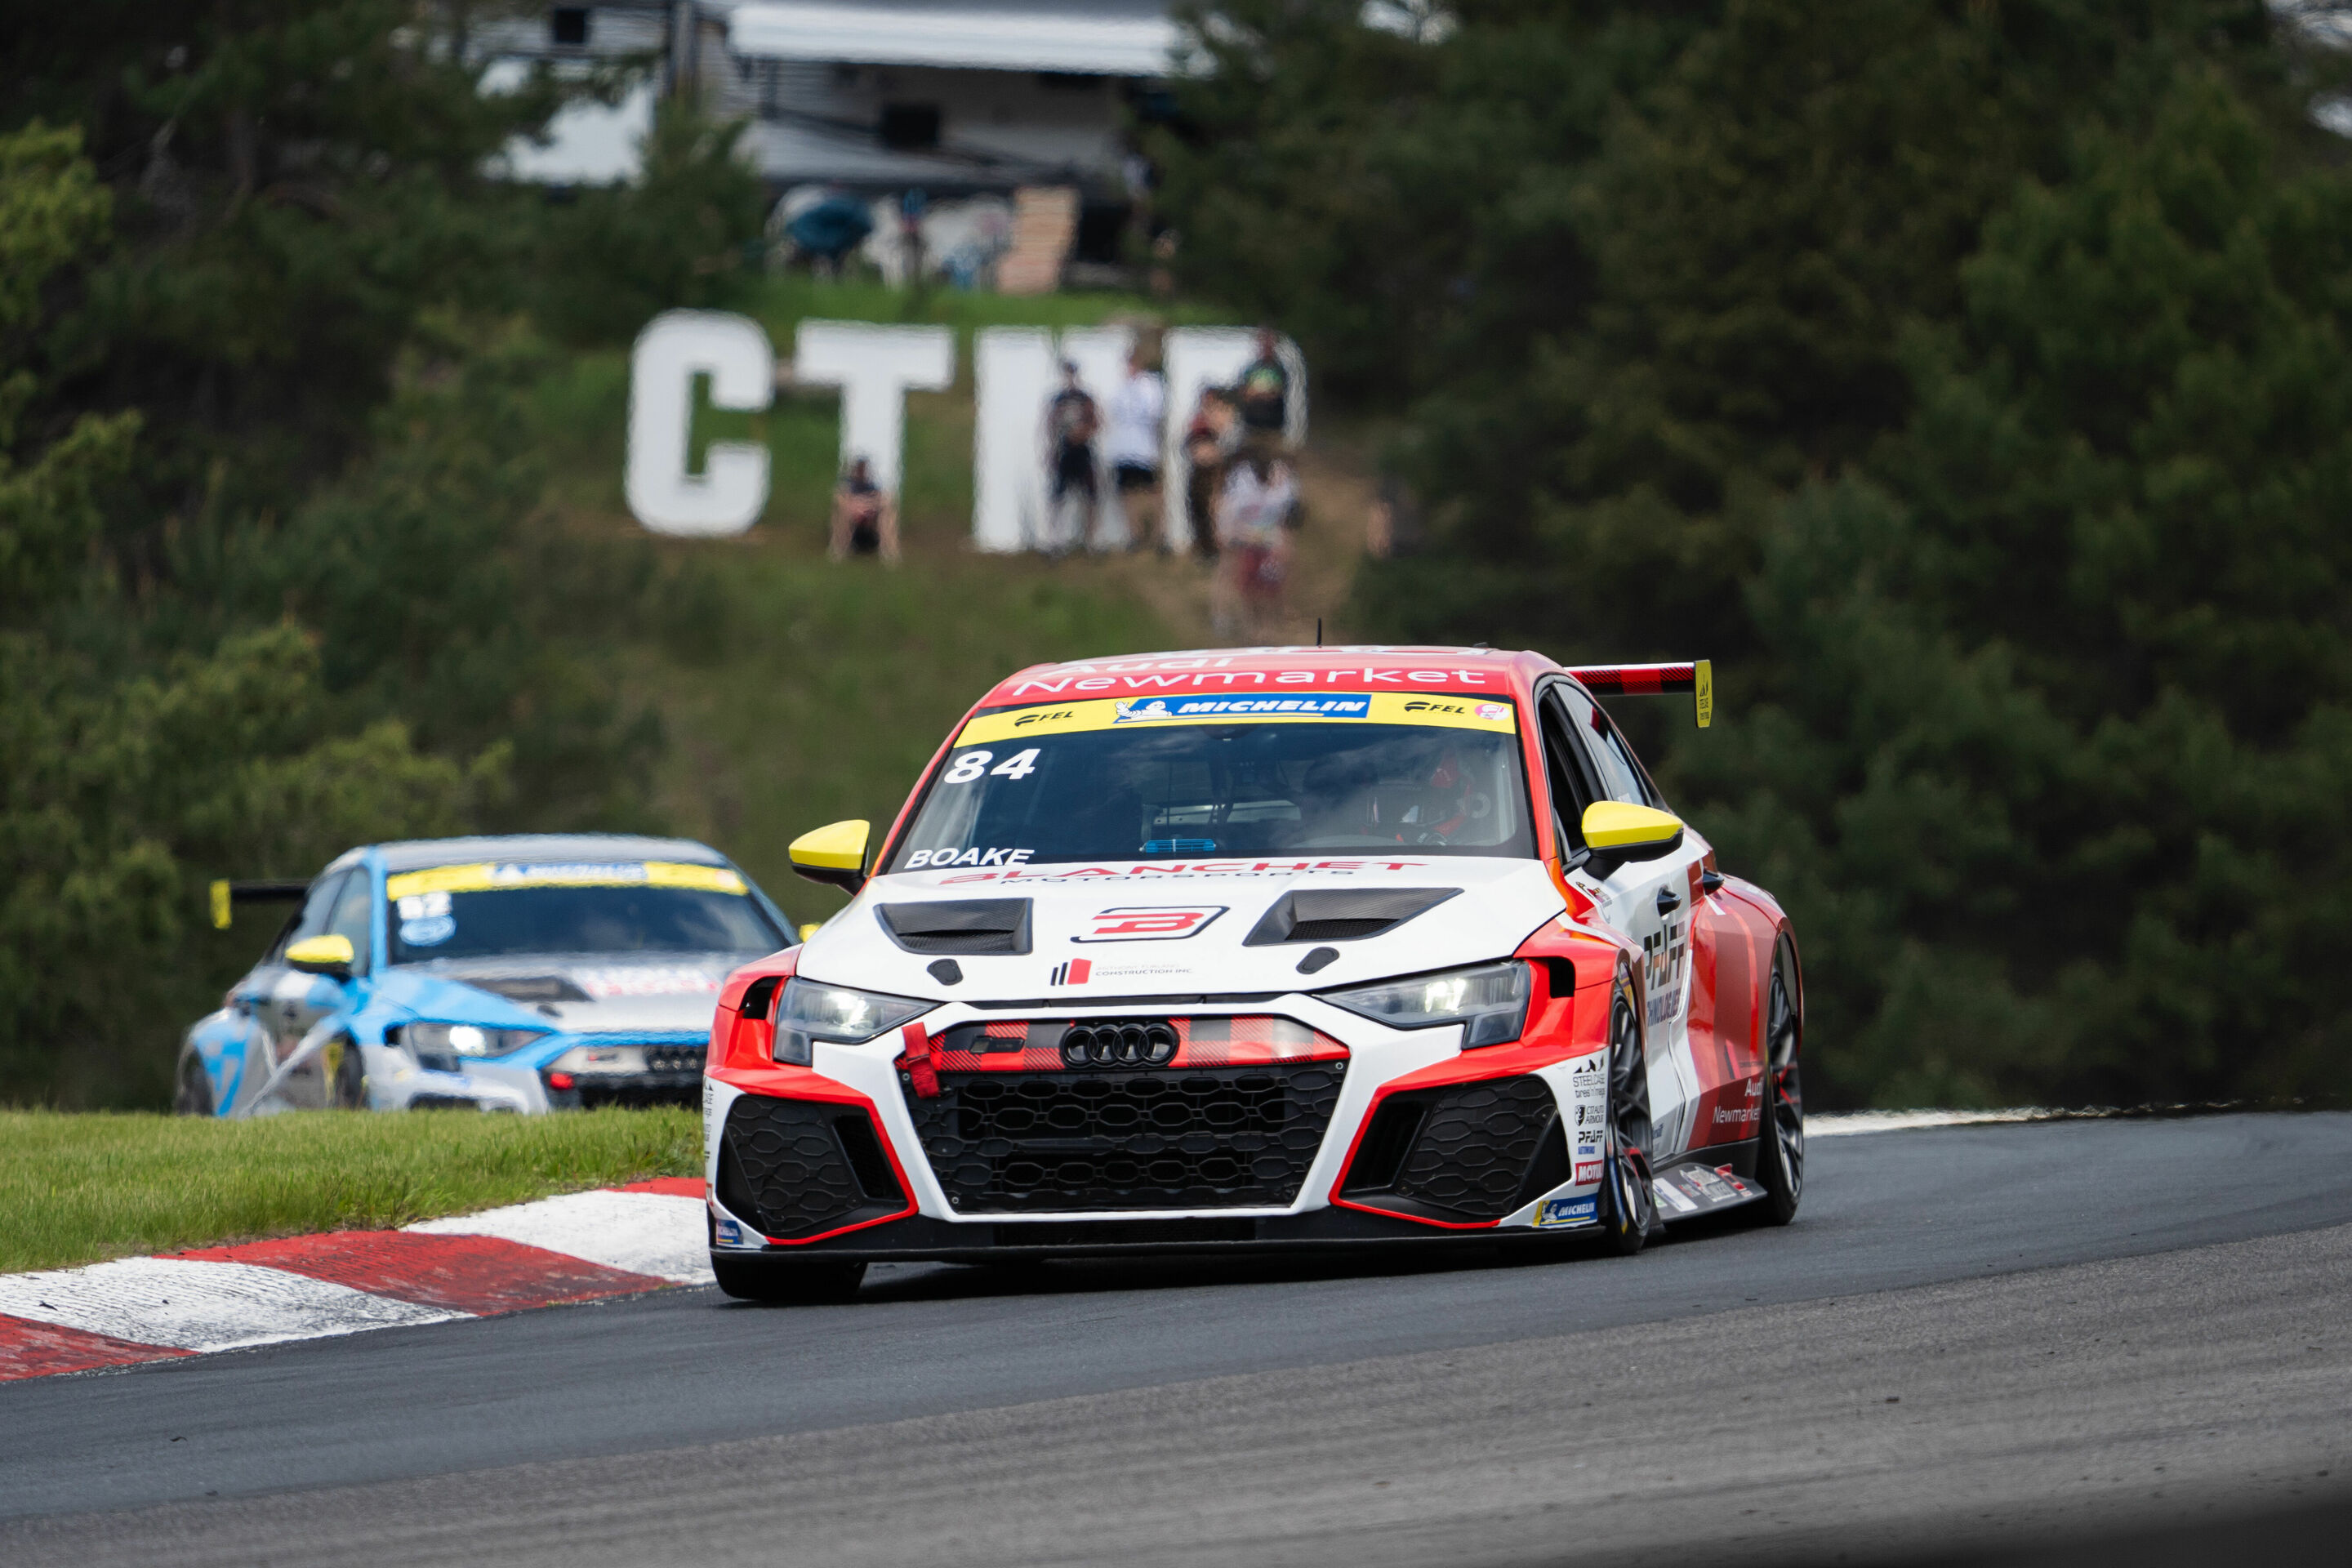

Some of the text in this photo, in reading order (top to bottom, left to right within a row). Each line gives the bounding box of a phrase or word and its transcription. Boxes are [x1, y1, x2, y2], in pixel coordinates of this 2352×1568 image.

[1040, 657, 1234, 678] Audi
[1012, 668, 1486, 696] Newmarket
[1178, 700, 1366, 714] MICHELIN
[944, 748, 1041, 784] 84
[903, 847, 1035, 869] BOAKE
[938, 861, 1430, 884] BLANCHET
[1000, 871, 1354, 884] MOTORSPORTS
[1095, 969, 1173, 977] CONSTRUCTION
[1558, 1202, 1595, 1217] MICHELIN
